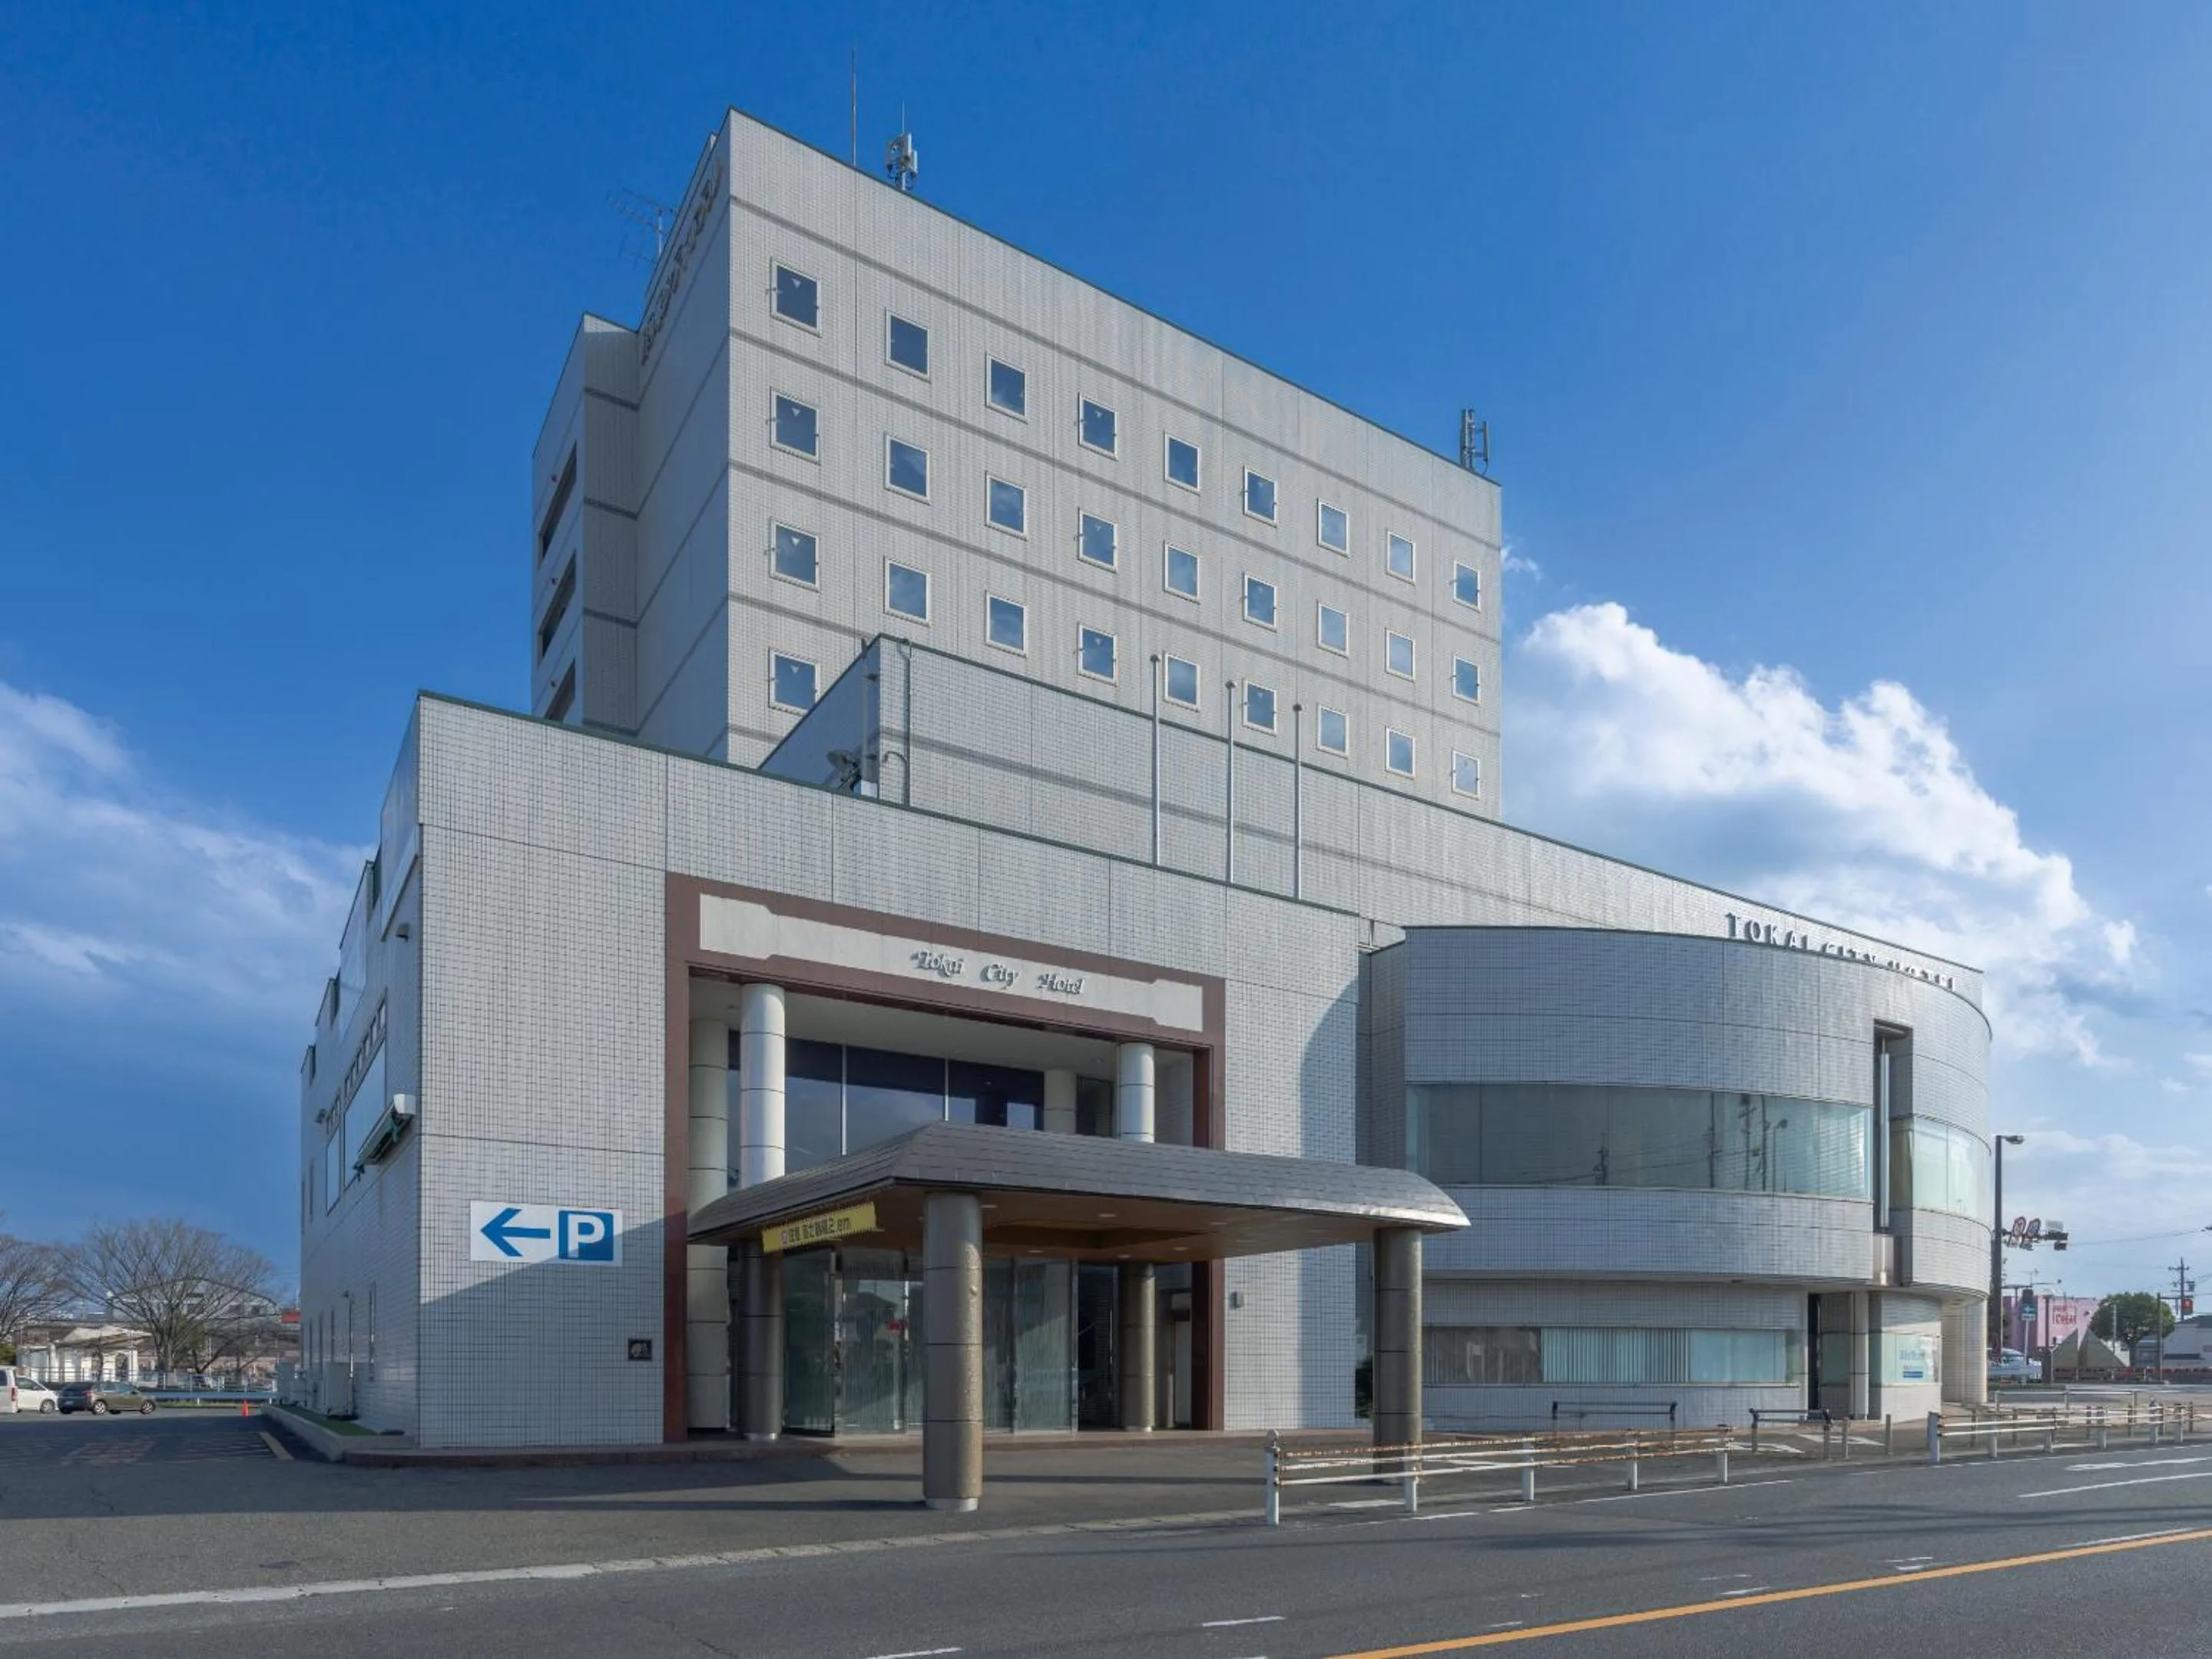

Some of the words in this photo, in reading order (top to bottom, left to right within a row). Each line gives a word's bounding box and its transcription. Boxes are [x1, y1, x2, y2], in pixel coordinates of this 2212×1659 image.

[1725, 912, 1809, 952] TOKAI
[911, 949, 965, 978] Tokai
[980, 963, 1020, 989] City
[1037, 972, 1085, 995] Hotel
[568, 1214, 605, 1258] P
